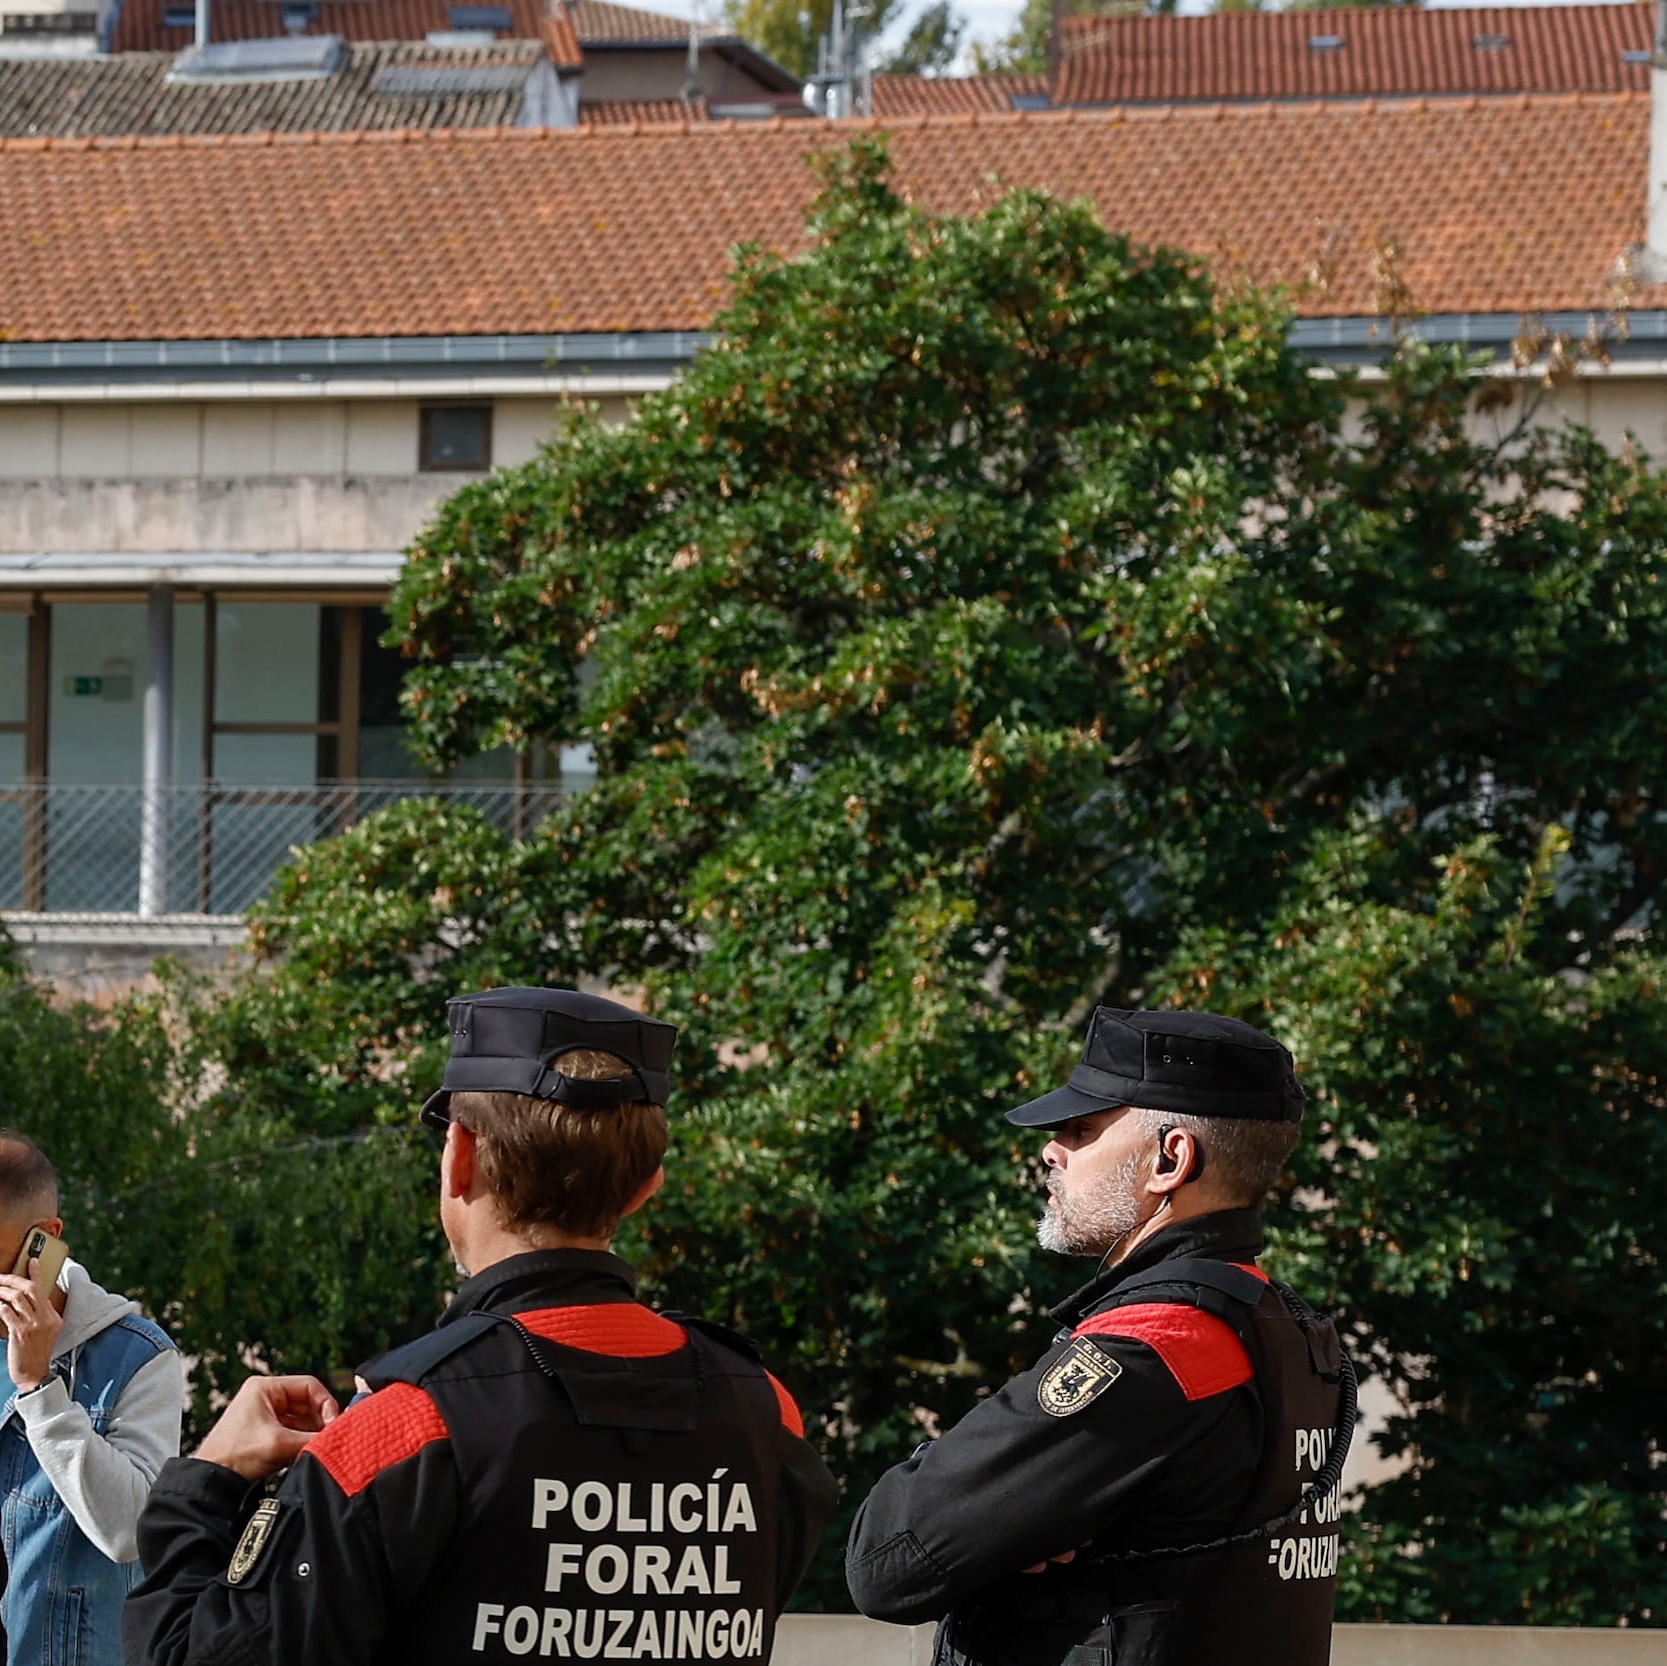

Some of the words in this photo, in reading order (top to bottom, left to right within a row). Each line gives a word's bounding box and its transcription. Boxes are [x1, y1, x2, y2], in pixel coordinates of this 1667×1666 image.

[531, 1468, 757, 1533] POLICÍA
[544, 1542, 742, 1595] FORAL
[472, 1602, 764, 1660] FORUZAINGOA
